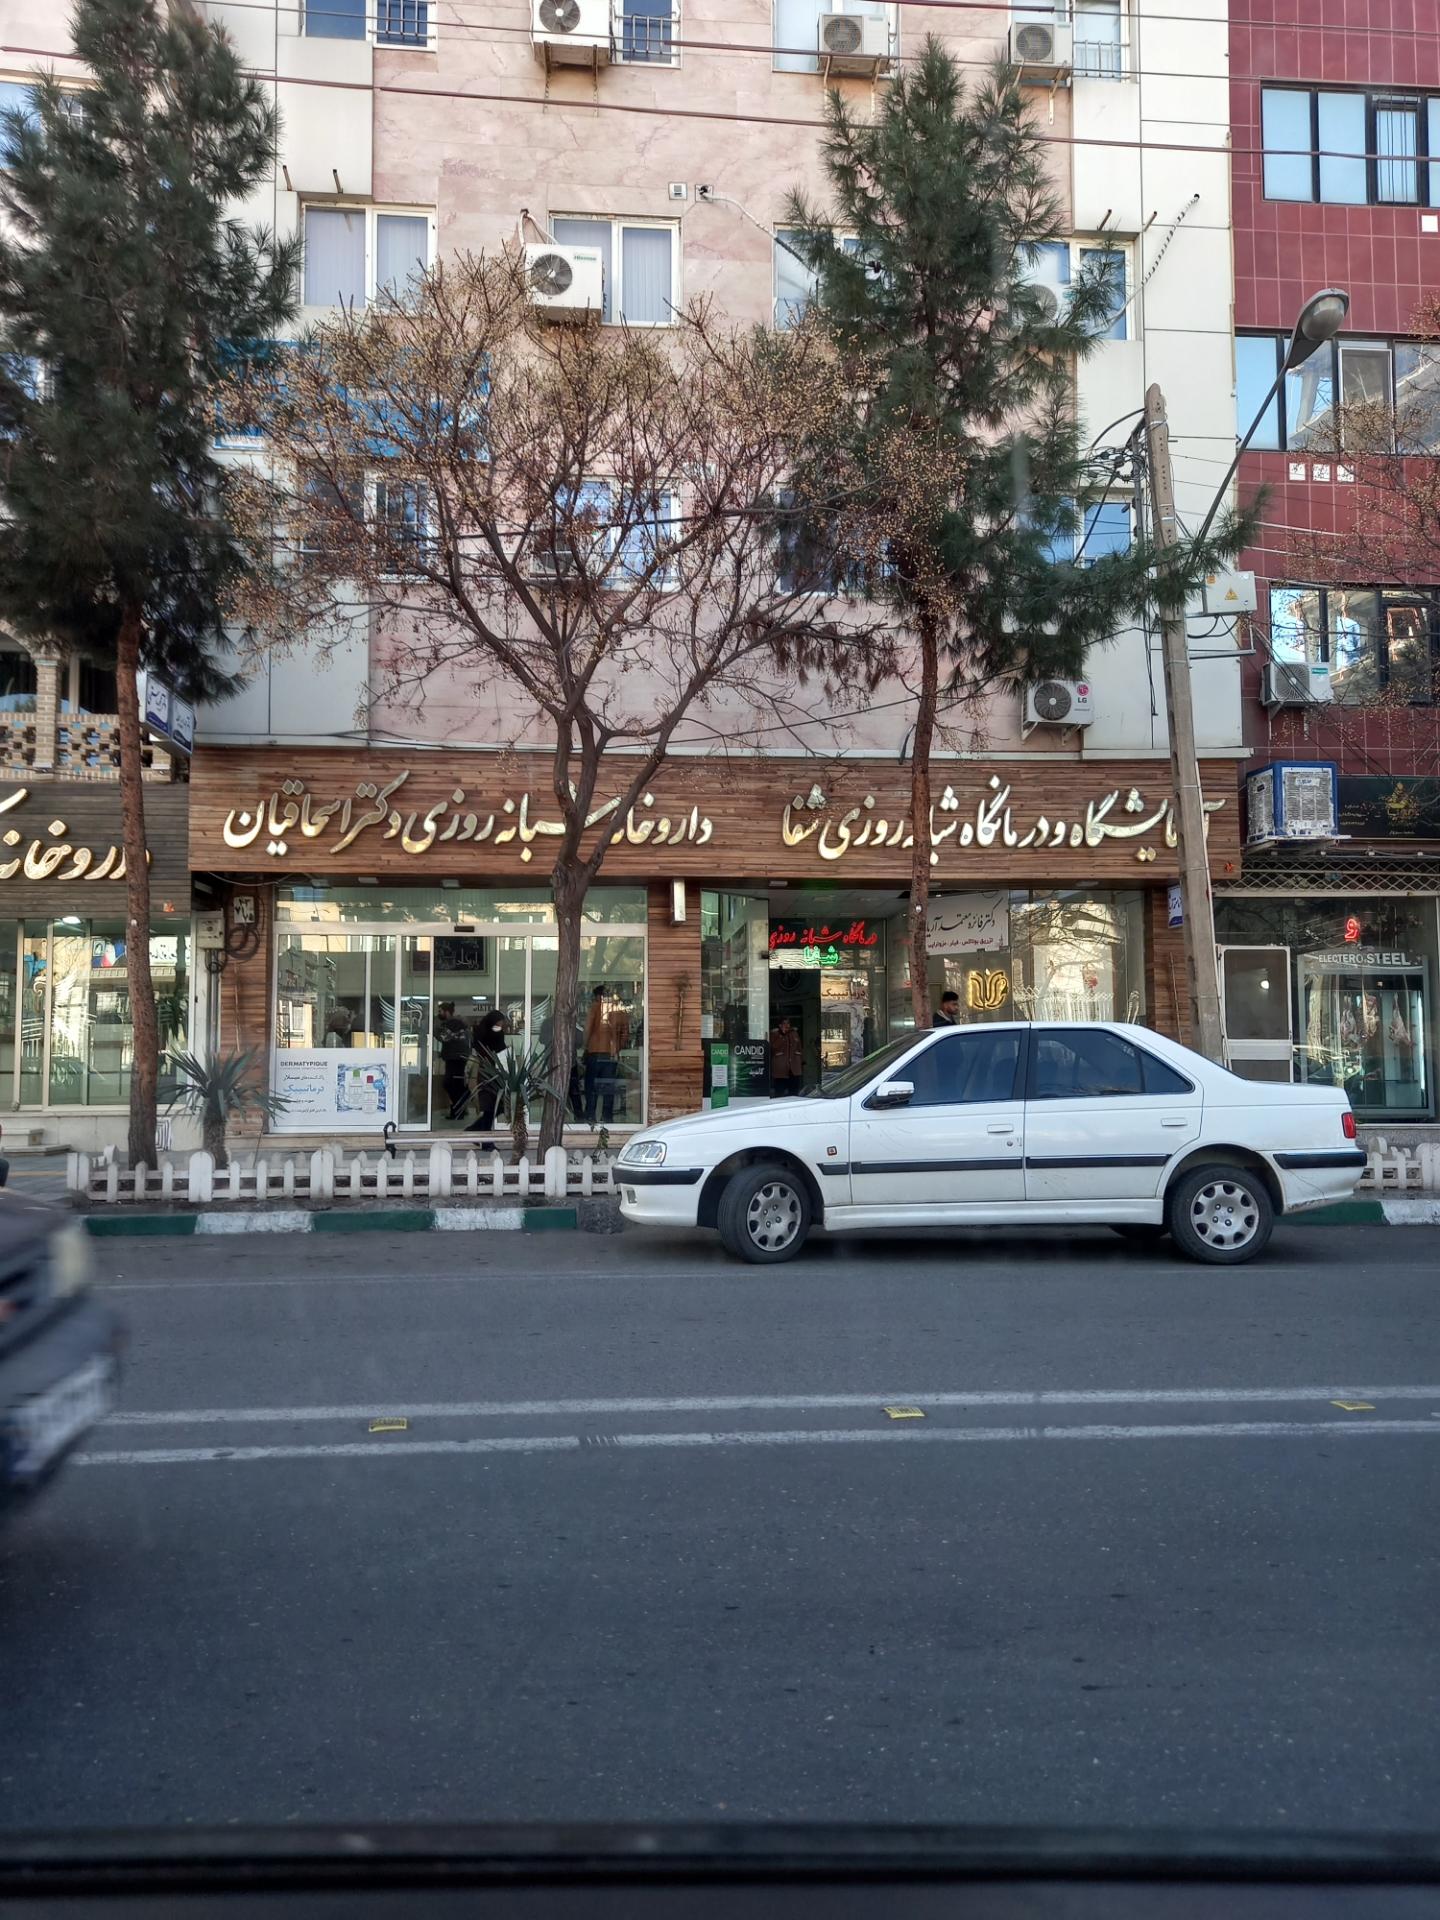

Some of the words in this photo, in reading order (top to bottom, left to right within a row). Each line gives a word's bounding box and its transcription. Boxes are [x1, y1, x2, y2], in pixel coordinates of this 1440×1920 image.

[222, 779, 352, 857] اسحاقیان
[329, 769, 410, 855] دکتر
[401, 788, 495, 855] روزی
[782, 783, 827, 847] شفا
[818, 794, 905, 860] روزی
[959, 774, 1050, 848] درمانگاه
[979, 896, 1005, 932] دکتر
[769, 925, 796, 951] روزی
[800, 927, 843, 948] شبانه
[842, 920, 878, 945] درمانگاه
[803, 945, 839, 965] شفا
[1319, 954, 1364, 964] ELECTERO
[1366, 952, 1411, 965] STEEL
[734, 1045, 765, 1056] CANDID
